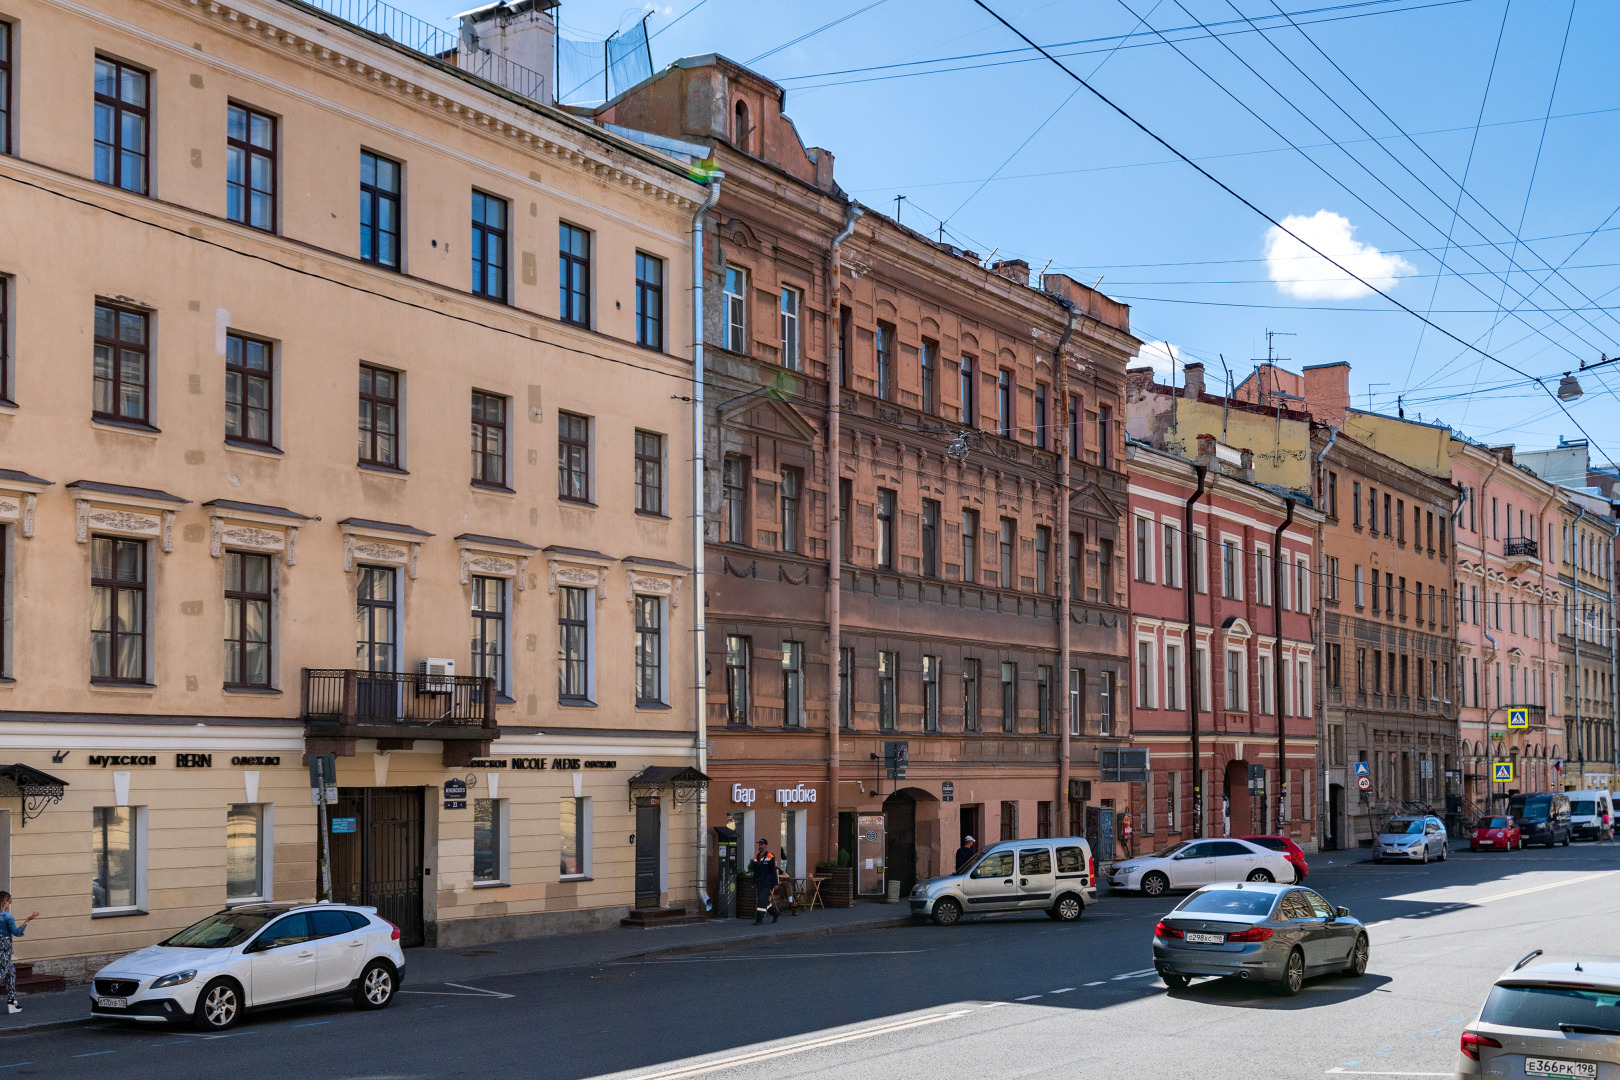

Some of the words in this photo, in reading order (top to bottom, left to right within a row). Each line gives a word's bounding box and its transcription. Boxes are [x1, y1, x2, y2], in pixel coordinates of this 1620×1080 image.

[89, 755, 156, 768] мужская
[176, 753, 212, 768] BERN
[231, 756, 281, 766] одежда
[466, 759, 508, 768] енская
[511, 757, 547, 770] NICOLE
[551, 757, 581, 770] ALEXIS
[732, 783, 756, 807] бар
[776, 783, 817, 807] пробка
[1528, 1060, 1574, 1074] Е366РК
[1576, 1063, 1594, 1073] 198
